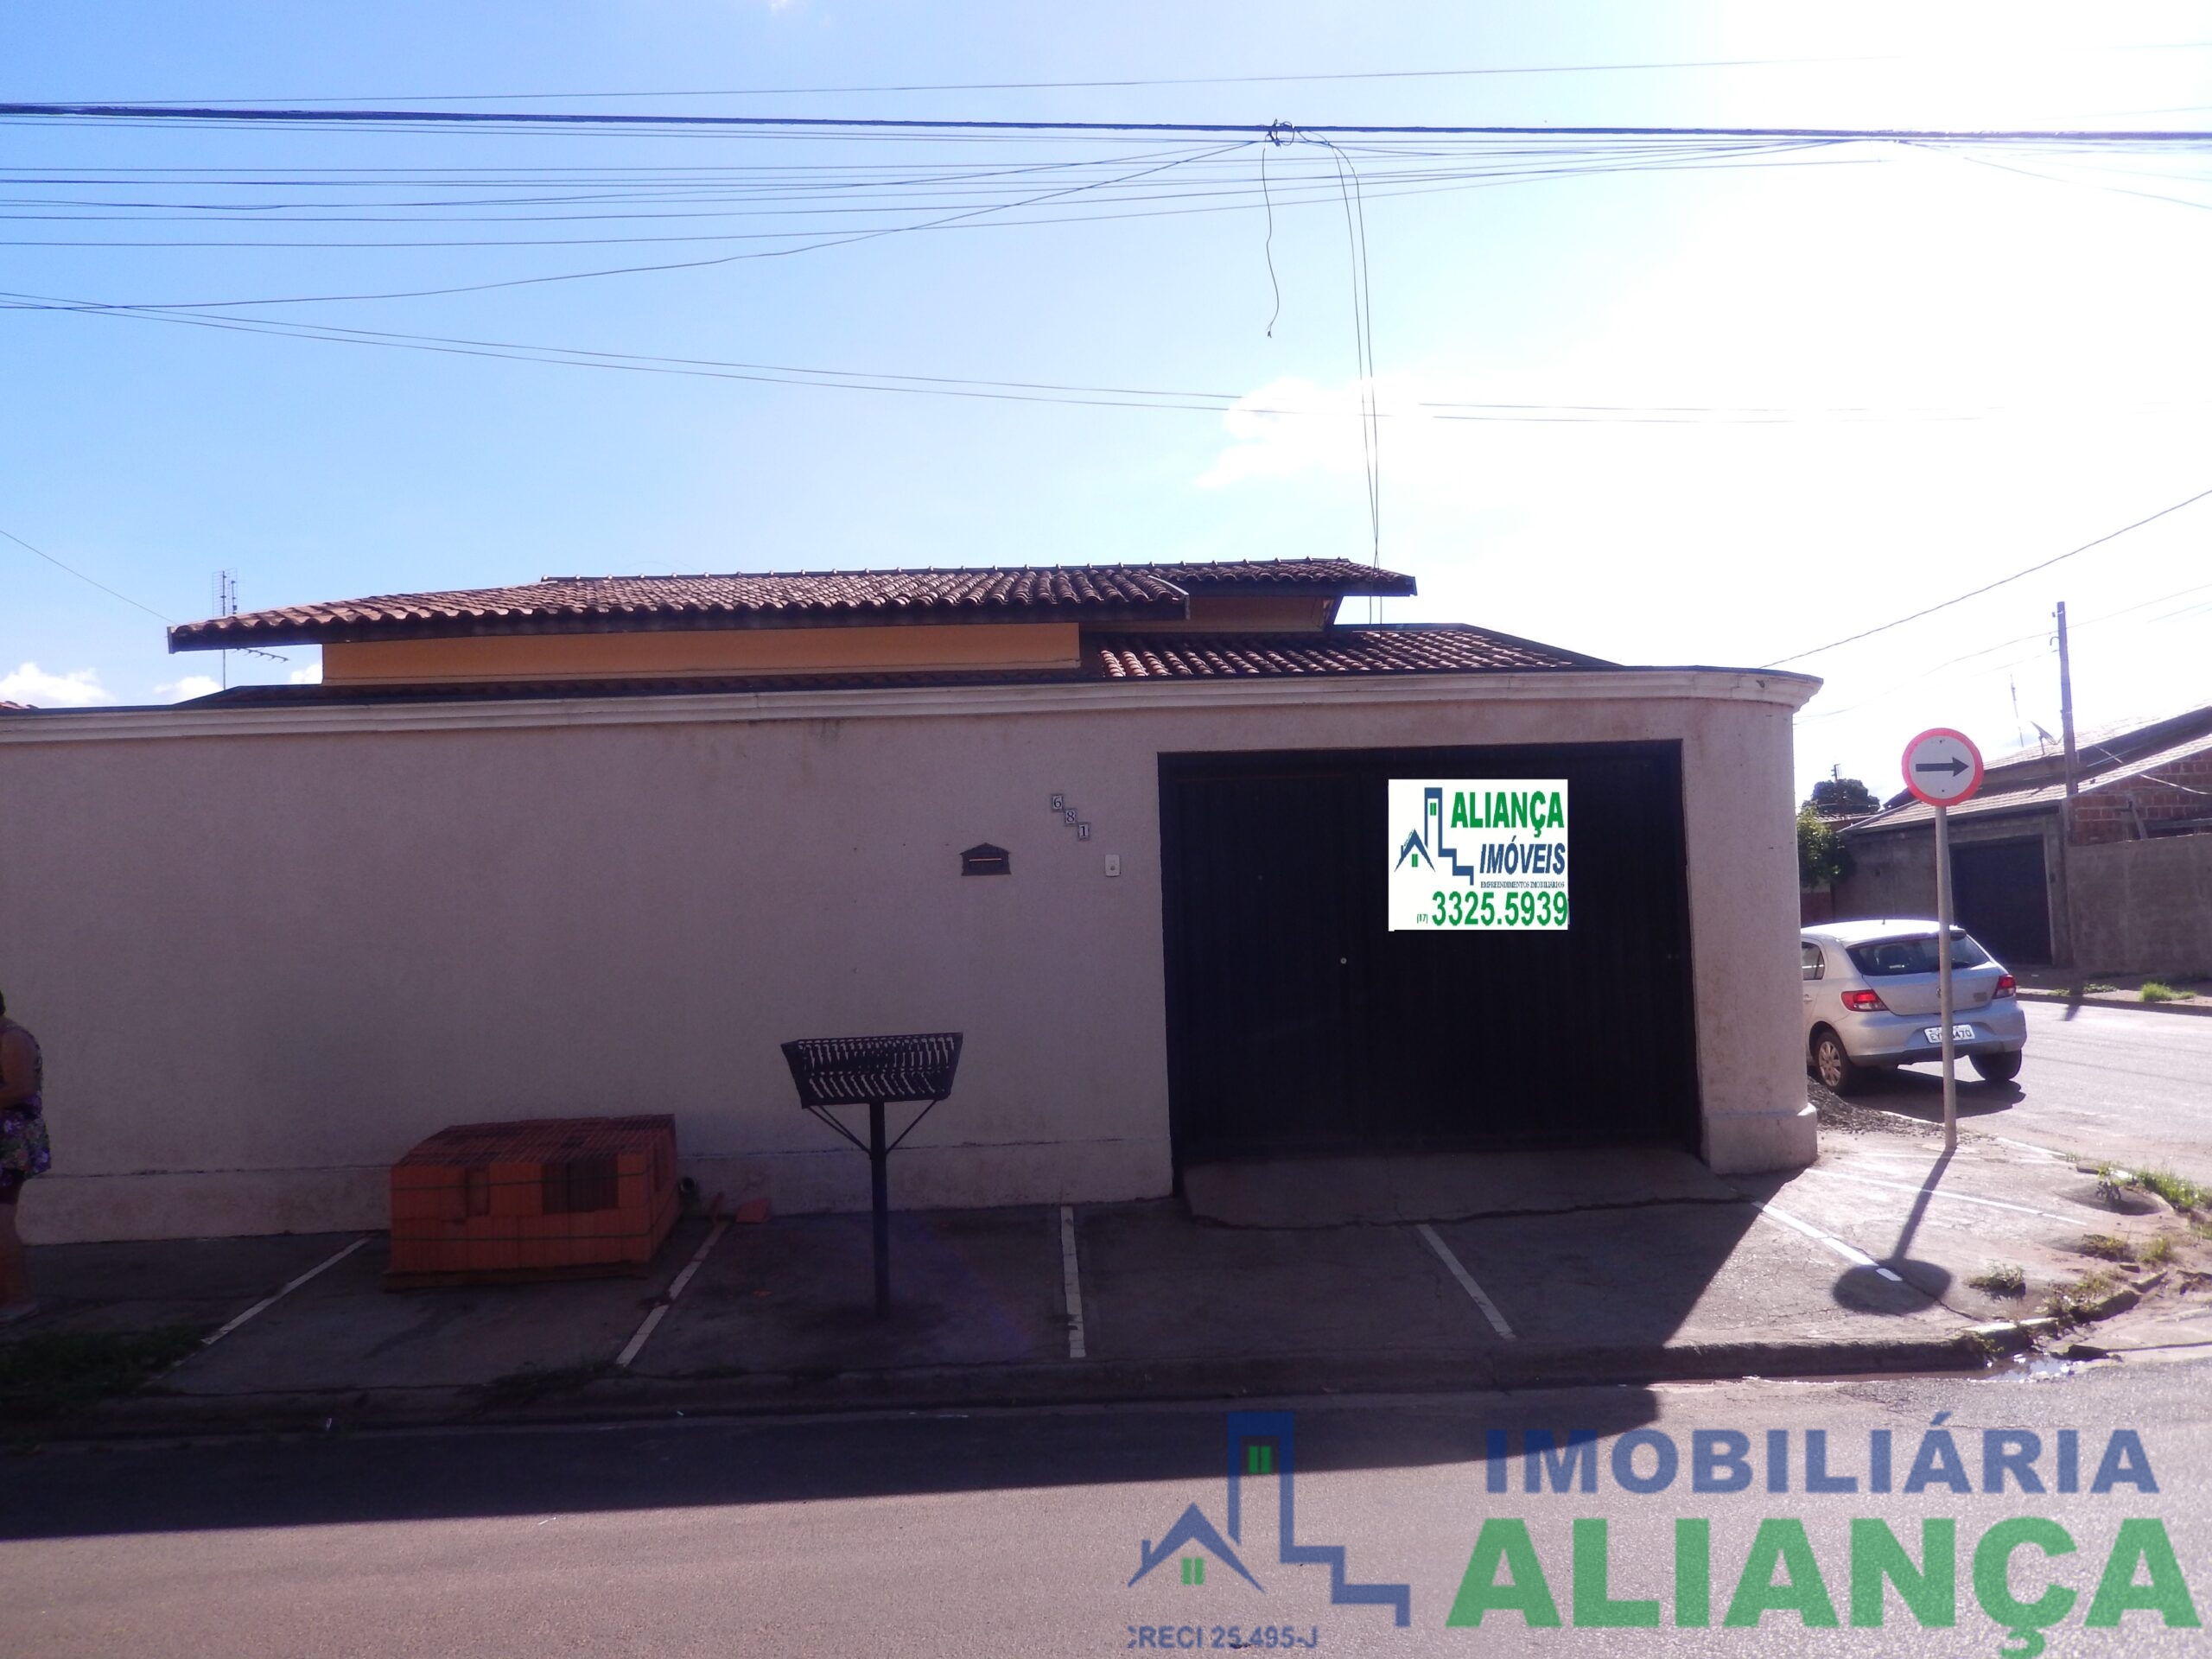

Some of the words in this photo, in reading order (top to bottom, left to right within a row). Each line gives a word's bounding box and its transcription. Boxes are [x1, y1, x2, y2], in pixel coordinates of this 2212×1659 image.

[1052, 795, 1088, 838] 681
[1451, 791, 1565, 838] ALIANÇA
[1479, 835, 1566, 875] IMÓVEIS
[1416, 913, 1428, 925] (17)
[1432, 891, 1568, 926] 3325.5939
